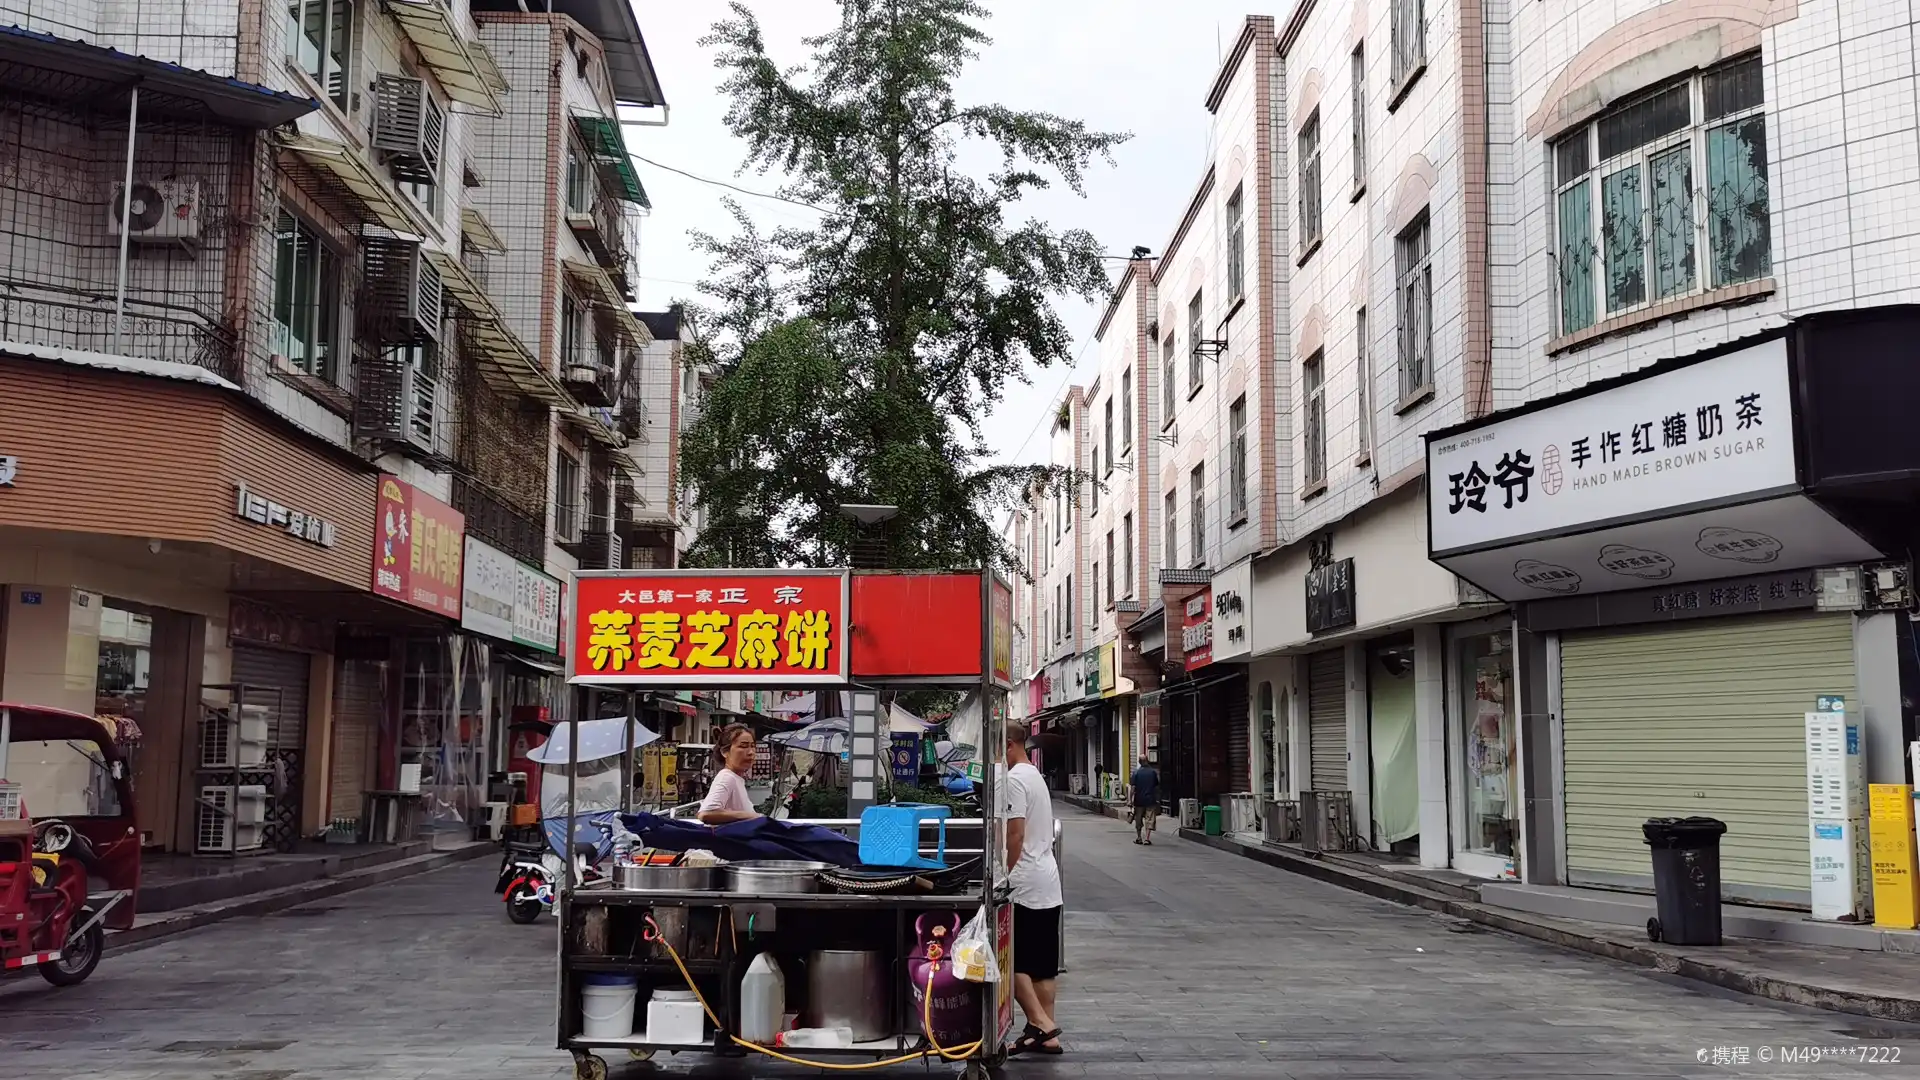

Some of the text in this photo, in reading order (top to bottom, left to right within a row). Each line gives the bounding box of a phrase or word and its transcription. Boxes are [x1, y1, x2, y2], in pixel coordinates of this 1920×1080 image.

[1571, 392, 1763, 470] 手作红糖奶茶
[1448, 448, 1535, 514] 玲爷
[1573, 436, 1766, 491] HAND MADE BROWN SUGAR
[618, 585, 803, 605] 大邑第一家 正宗
[1653, 590, 1701, 613] 真红糖
[1709, 584, 1761, 607] 好茶底
[587, 608, 833, 671] 荞麦芝麻饼
